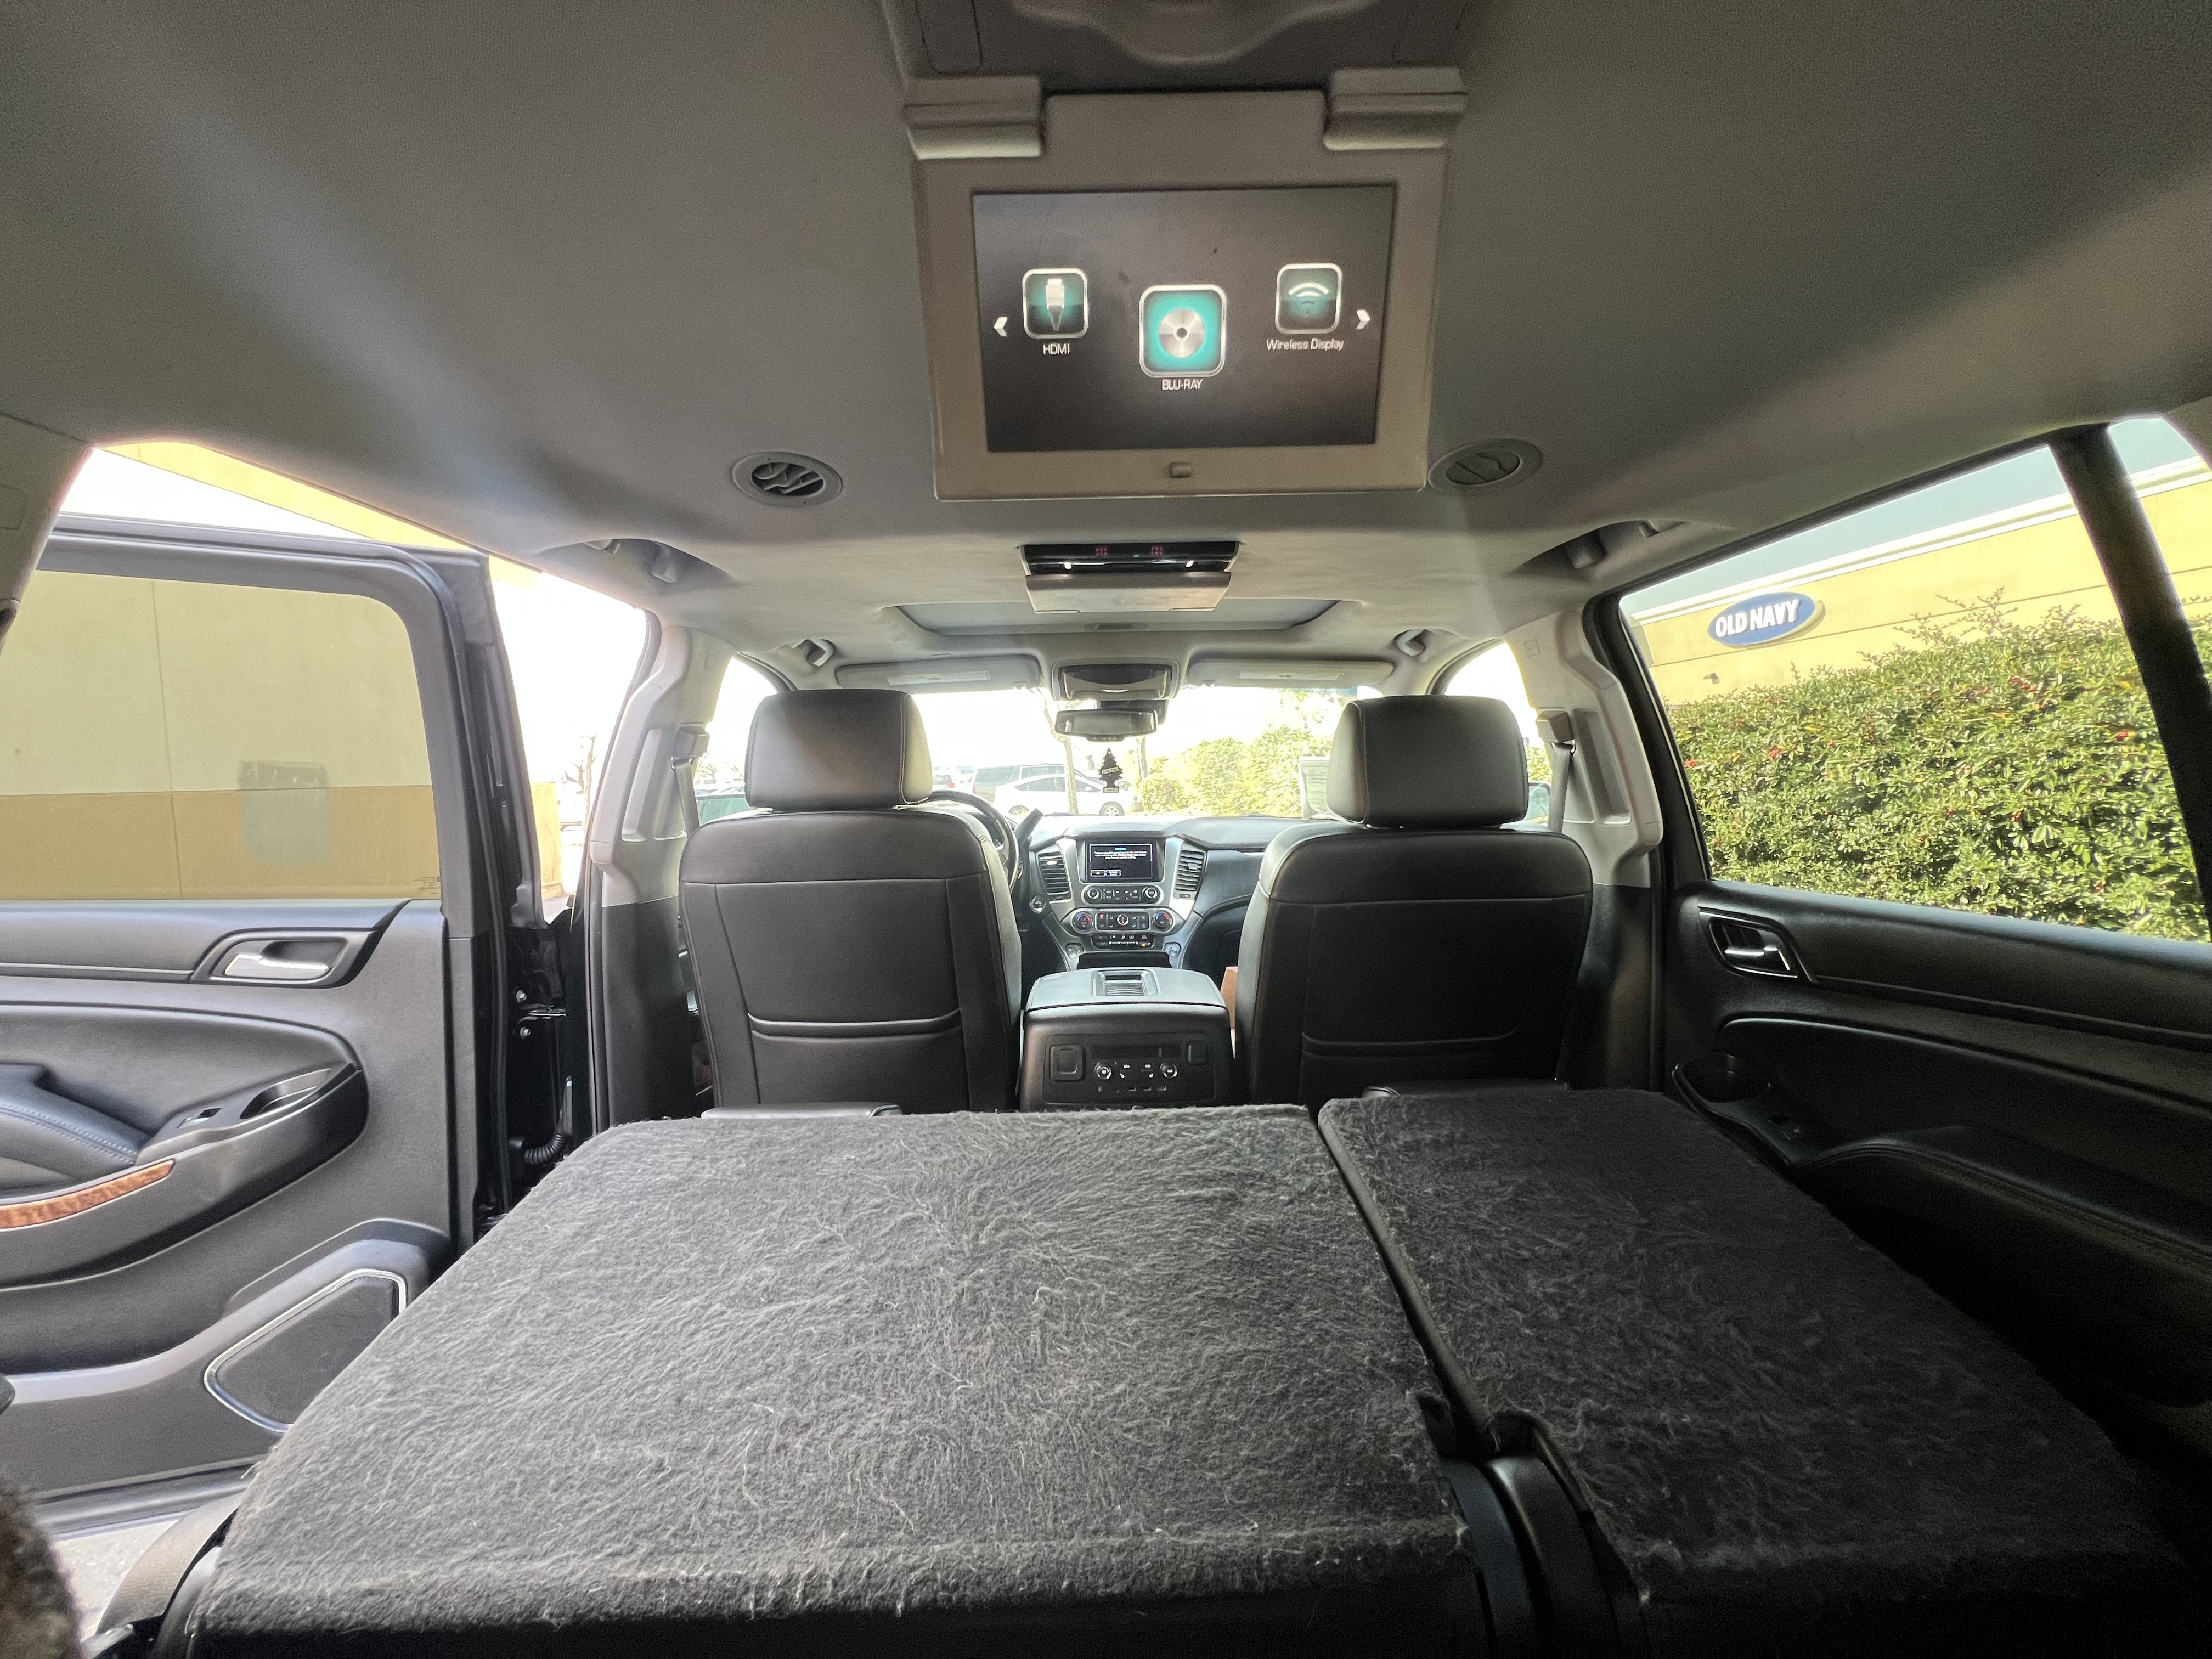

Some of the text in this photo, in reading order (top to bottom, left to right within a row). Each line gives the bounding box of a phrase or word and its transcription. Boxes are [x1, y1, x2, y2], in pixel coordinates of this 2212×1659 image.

[1043, 343, 1070, 356] HDMI
[1266, 338, 1344, 352] Wireless Display
[1161, 379, 1203, 391] BLU-RAY
[1715, 599, 1800, 637] OLD NAVY
